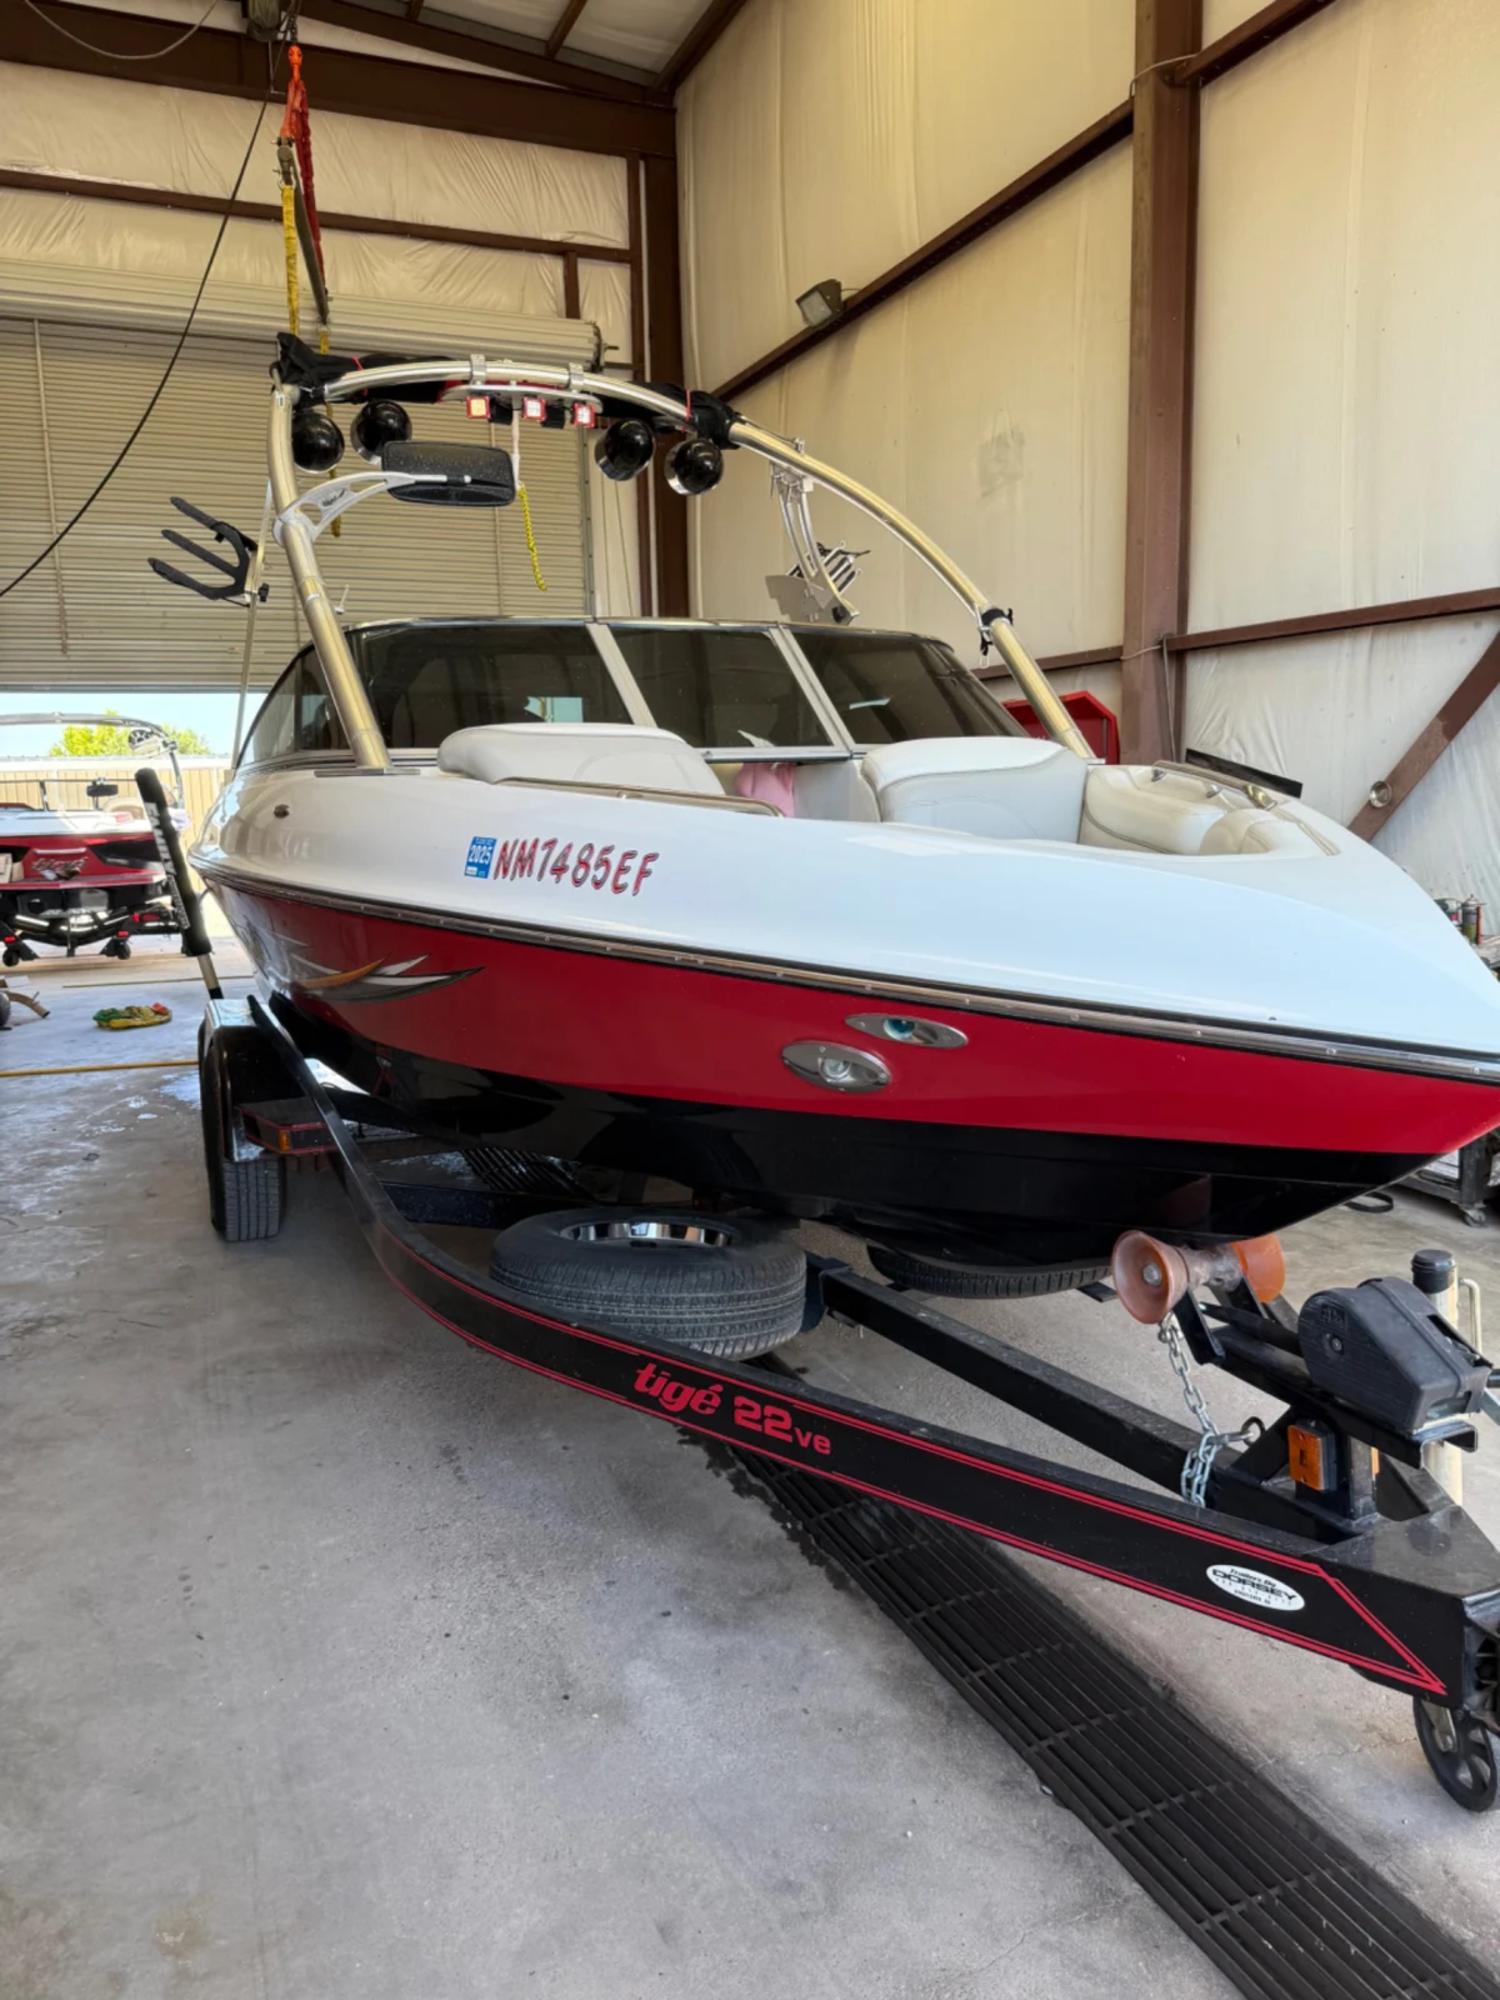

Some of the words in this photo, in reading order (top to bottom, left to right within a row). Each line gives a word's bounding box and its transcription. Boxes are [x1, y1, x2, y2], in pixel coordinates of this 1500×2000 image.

[144, 802, 177, 876] FAMILY
[468, 844, 491, 865] 2025
[493, 837, 660, 896] NM7485EF
[634, 1362, 724, 1414] tigé
[1212, 1568, 1297, 1600] DORSEY
